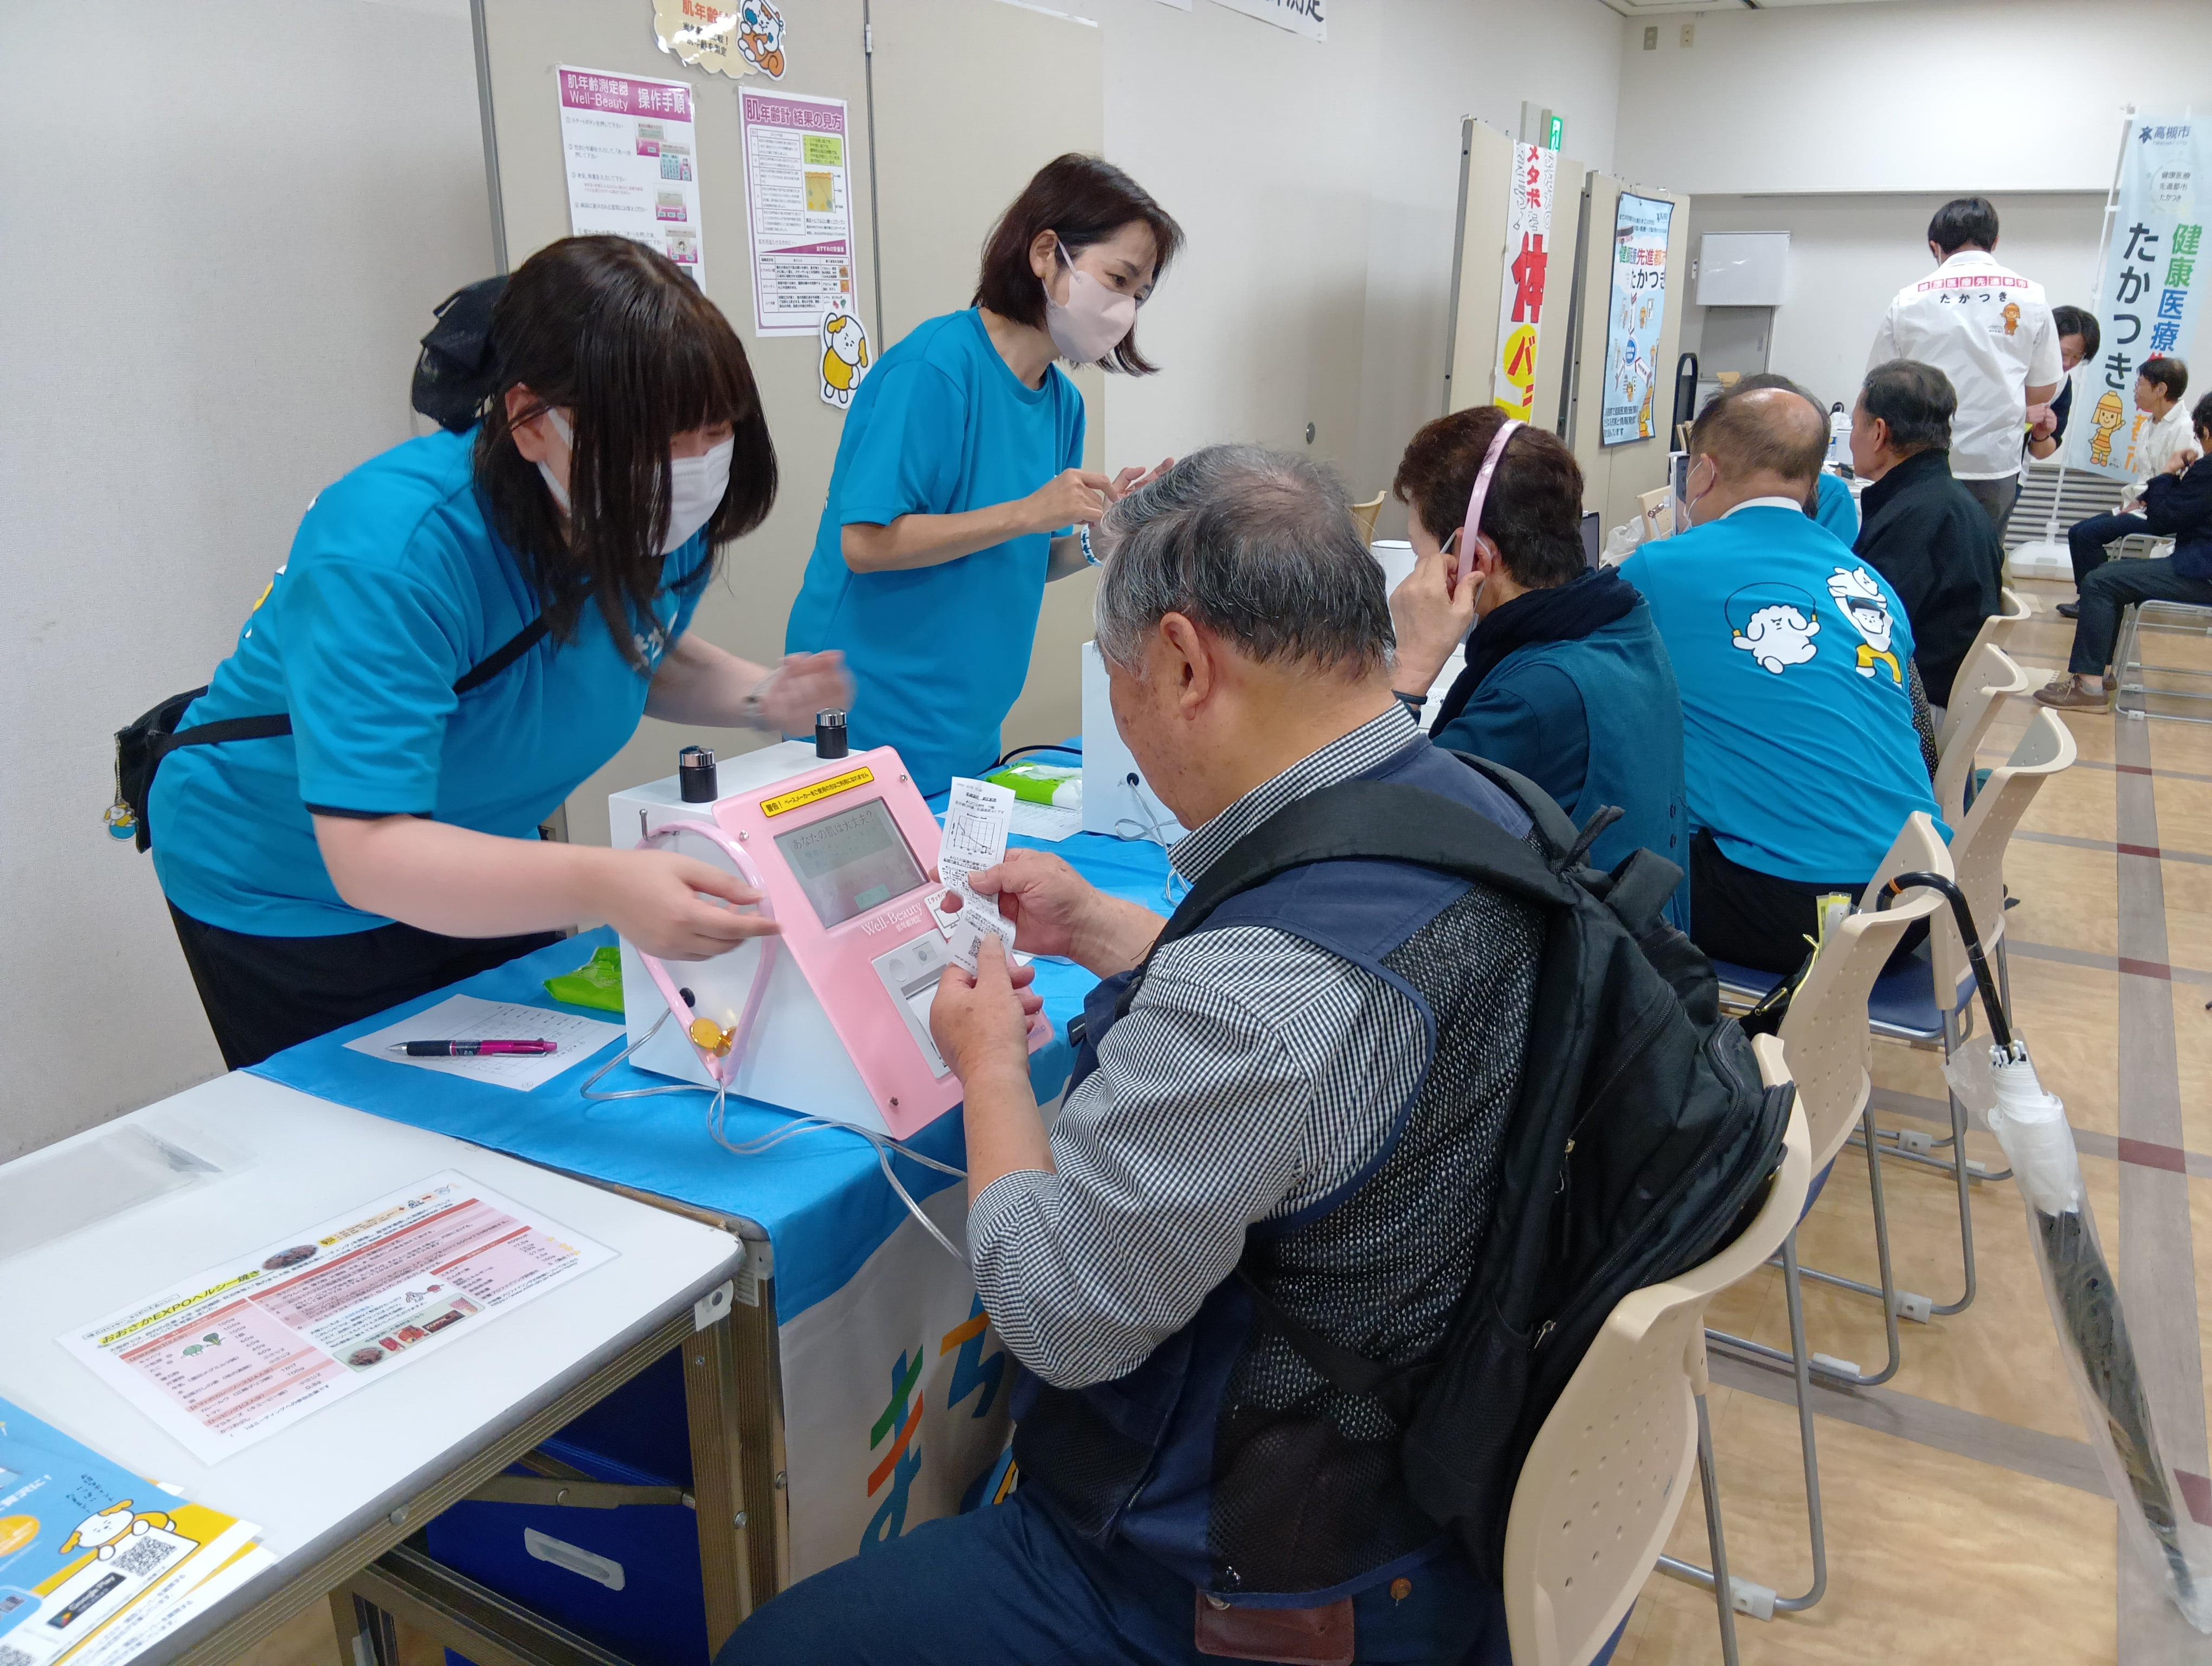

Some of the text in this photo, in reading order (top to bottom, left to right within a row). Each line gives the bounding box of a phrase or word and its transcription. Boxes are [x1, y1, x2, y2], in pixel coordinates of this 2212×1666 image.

[568, 73, 685, 114] 肌年齢測定器 操作手順
[569, 90, 628, 112] Well-Beauty
[746, 98, 843, 130] 肌年齢計 結果の見方
[2155, 125, 2191, 139] 高槻市
[1526, 145, 1541, 209] メタボ
[2160, 194, 2182, 202] たかつき
[1940, 291, 2008, 304] たかつき
[2105, 222, 2159, 390] たかつき
[861, 903, 922, 936] Well-Beauty
[896, 914, 922, 932] 肌年齢測定
[97, 1268, 263, 1344] おおさかEXPOヘルシー焼き
